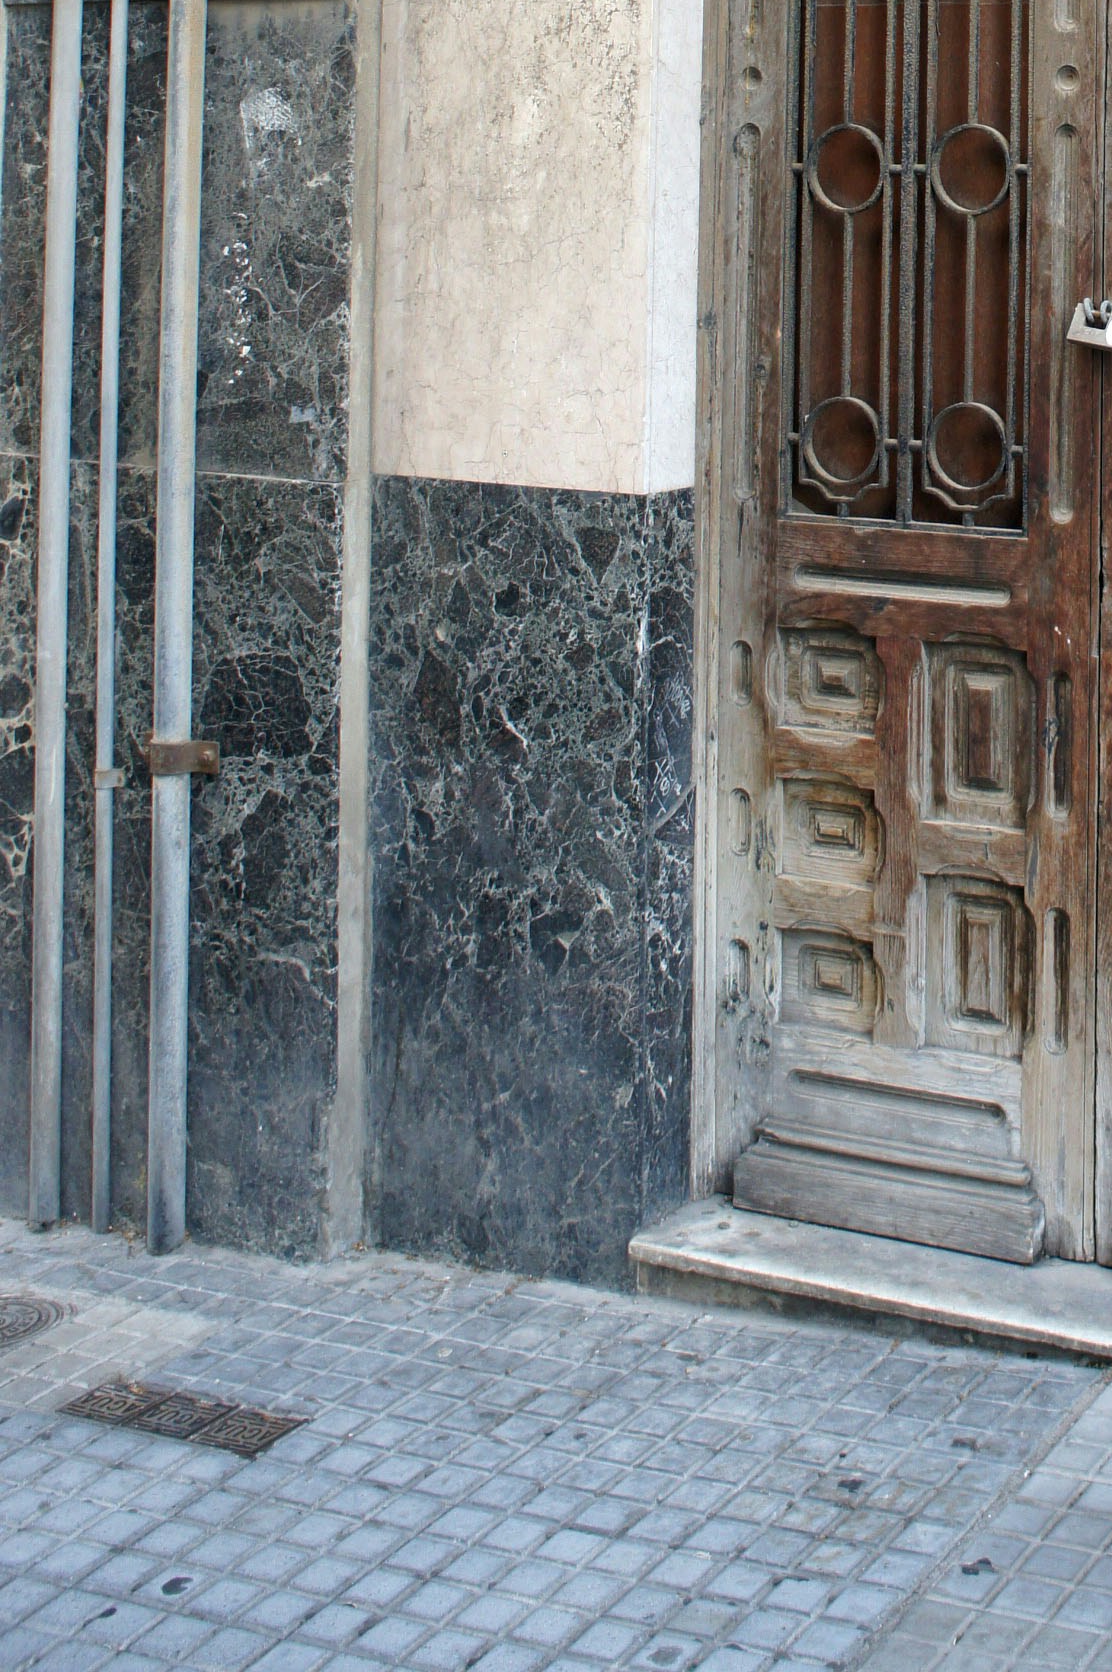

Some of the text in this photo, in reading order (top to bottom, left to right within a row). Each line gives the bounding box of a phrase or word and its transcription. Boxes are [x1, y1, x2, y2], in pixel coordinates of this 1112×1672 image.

[80, 1393, 136, 1414] AGUA
[147, 1407, 206, 1428] AGUA
[216, 1422, 275, 1442] AGUA
